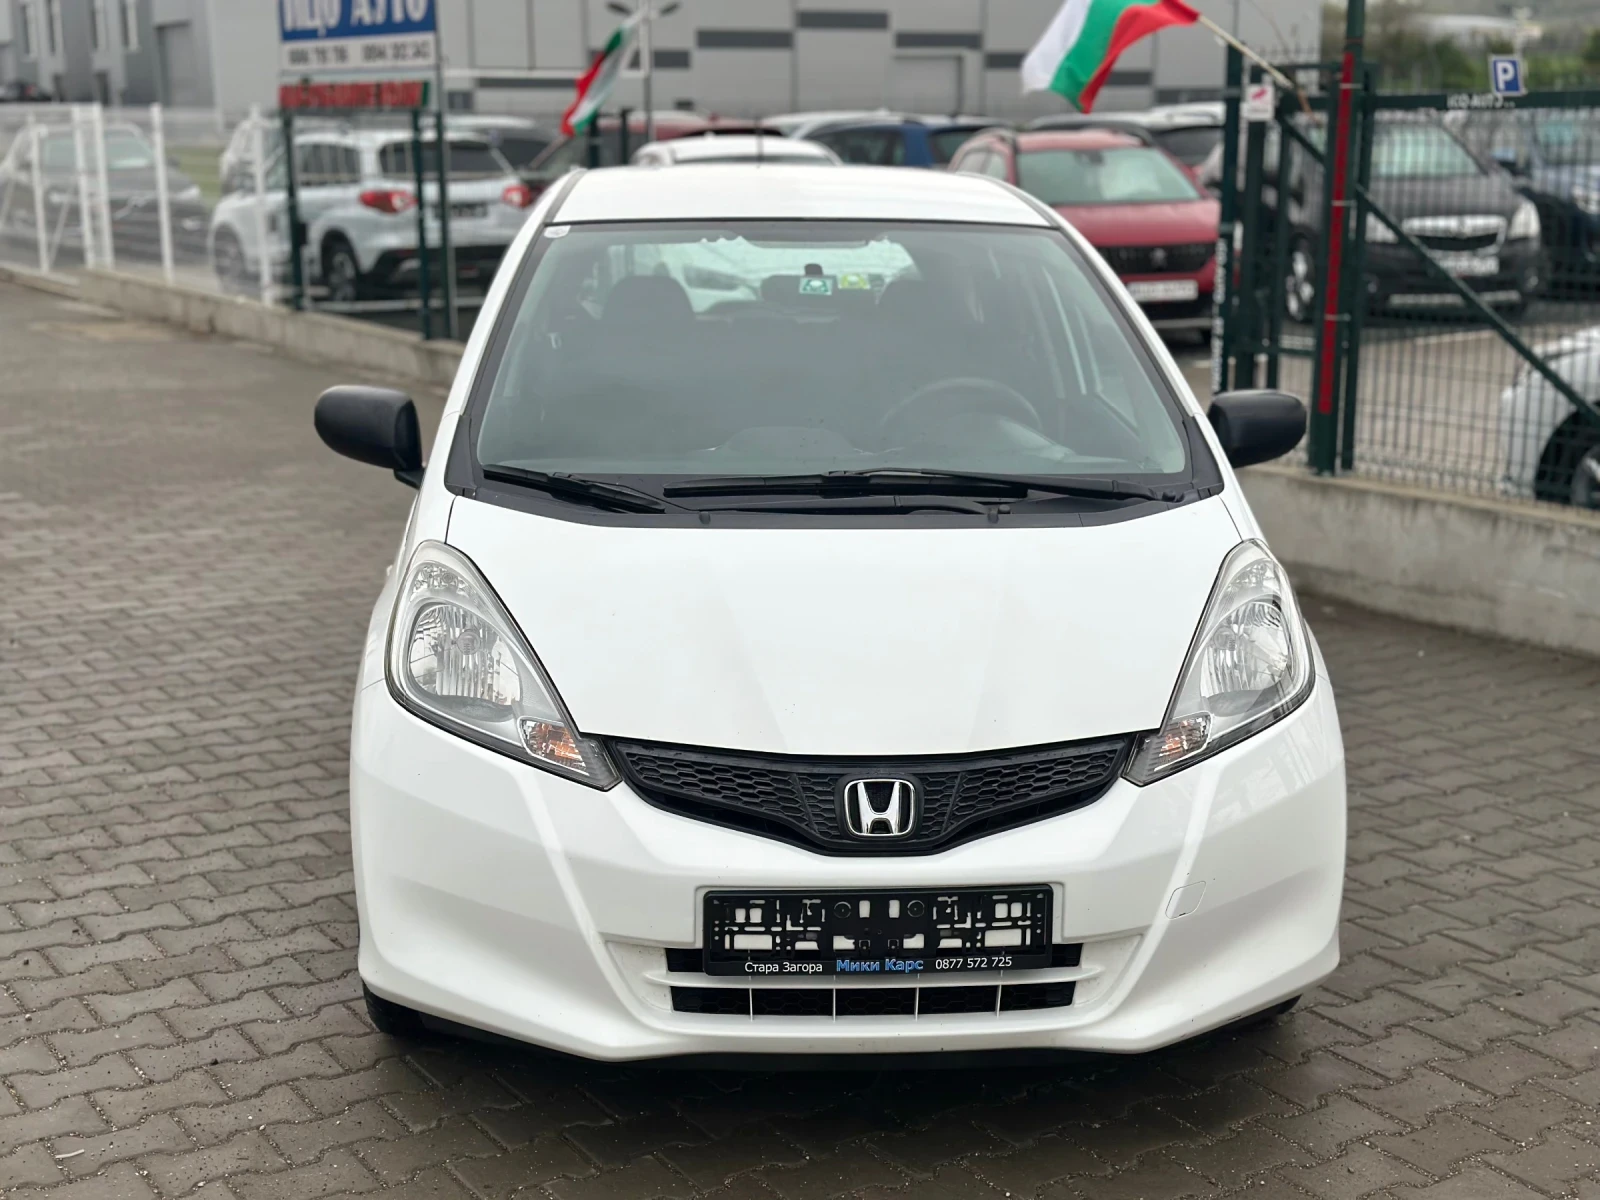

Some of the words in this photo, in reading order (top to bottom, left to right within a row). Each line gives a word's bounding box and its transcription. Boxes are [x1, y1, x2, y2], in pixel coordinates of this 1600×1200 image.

[1496, 61, 1515, 91] P
[744, 961, 779, 974] Стара
[782, 961, 823, 975] Загора
[836, 959, 880, 972] Мики
[884, 958, 924, 974] Карс
[935, 958, 963, 970] 0877
[967, 957, 988, 969] 572
[991, 956, 1013, 968] 725
